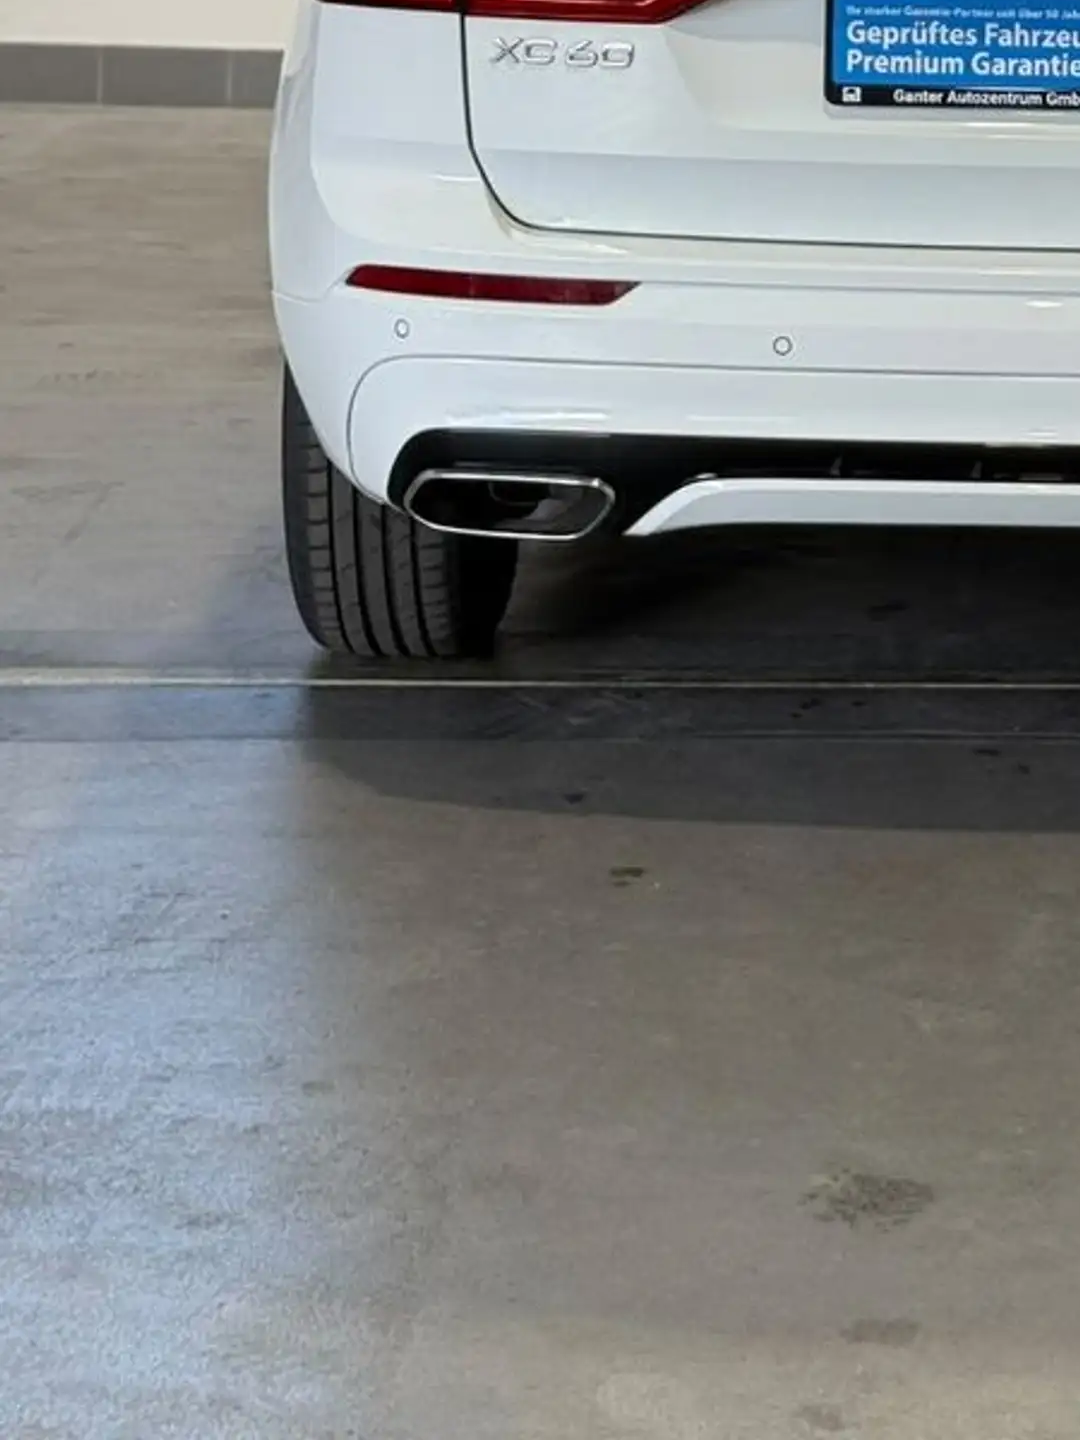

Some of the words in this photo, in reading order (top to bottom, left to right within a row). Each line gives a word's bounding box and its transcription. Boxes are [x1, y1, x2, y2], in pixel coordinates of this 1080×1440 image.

[846, 20, 977, 50] Geprüftes
[489, 36, 636, 71] XC60
[846, 49, 964, 76] Premium
[893, 88, 943, 104] Ganter
[947, 90, 1043, 106] Autozentrum
